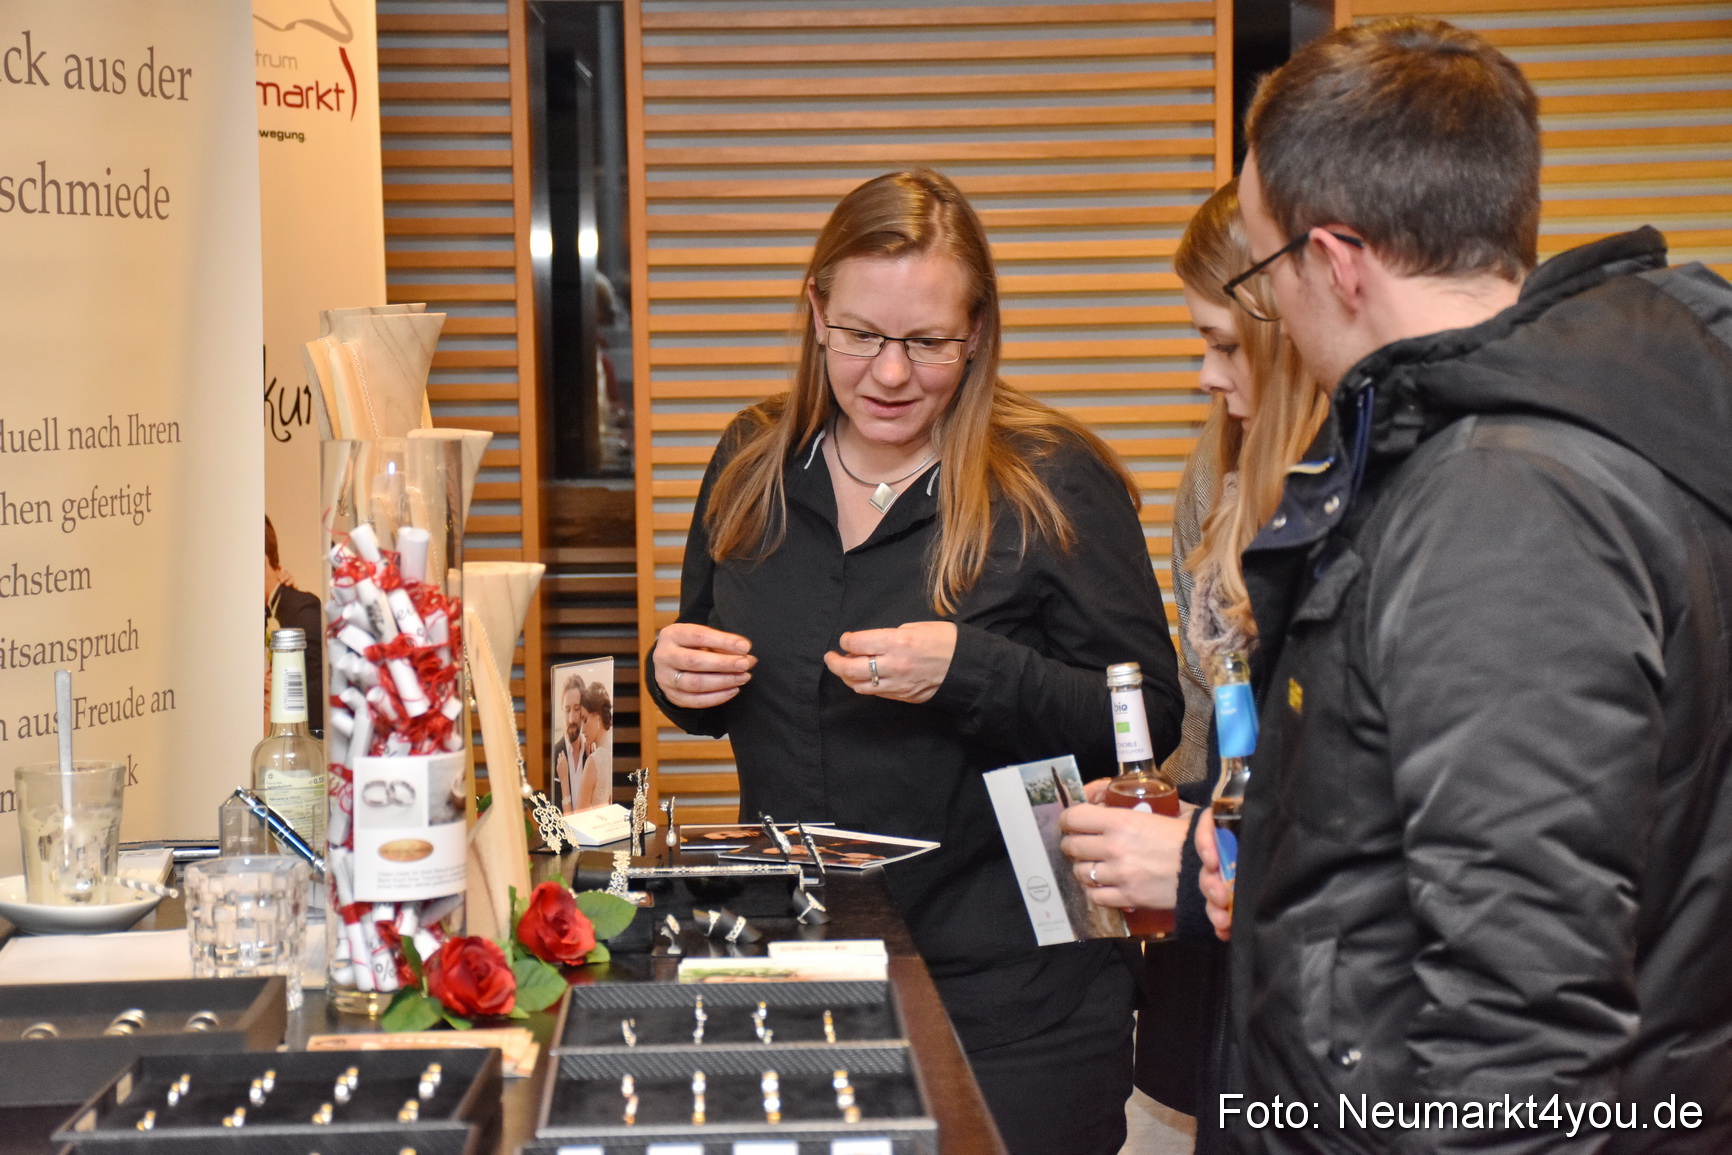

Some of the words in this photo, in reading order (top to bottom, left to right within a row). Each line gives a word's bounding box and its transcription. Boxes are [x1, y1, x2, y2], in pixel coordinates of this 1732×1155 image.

[0, 30, 50, 87] ck
[63, 53, 127, 95] aus
[137, 45, 192, 102] der
[0, 160, 170, 220] schmiede
[67, 414, 121, 450] nach
[127, 412, 181, 446] Ihren
[61, 483, 152, 534] gefertigt
[0, 562, 92, 598] chstem
[72, 685, 146, 731] Freude
[150, 687, 177, 714] an
